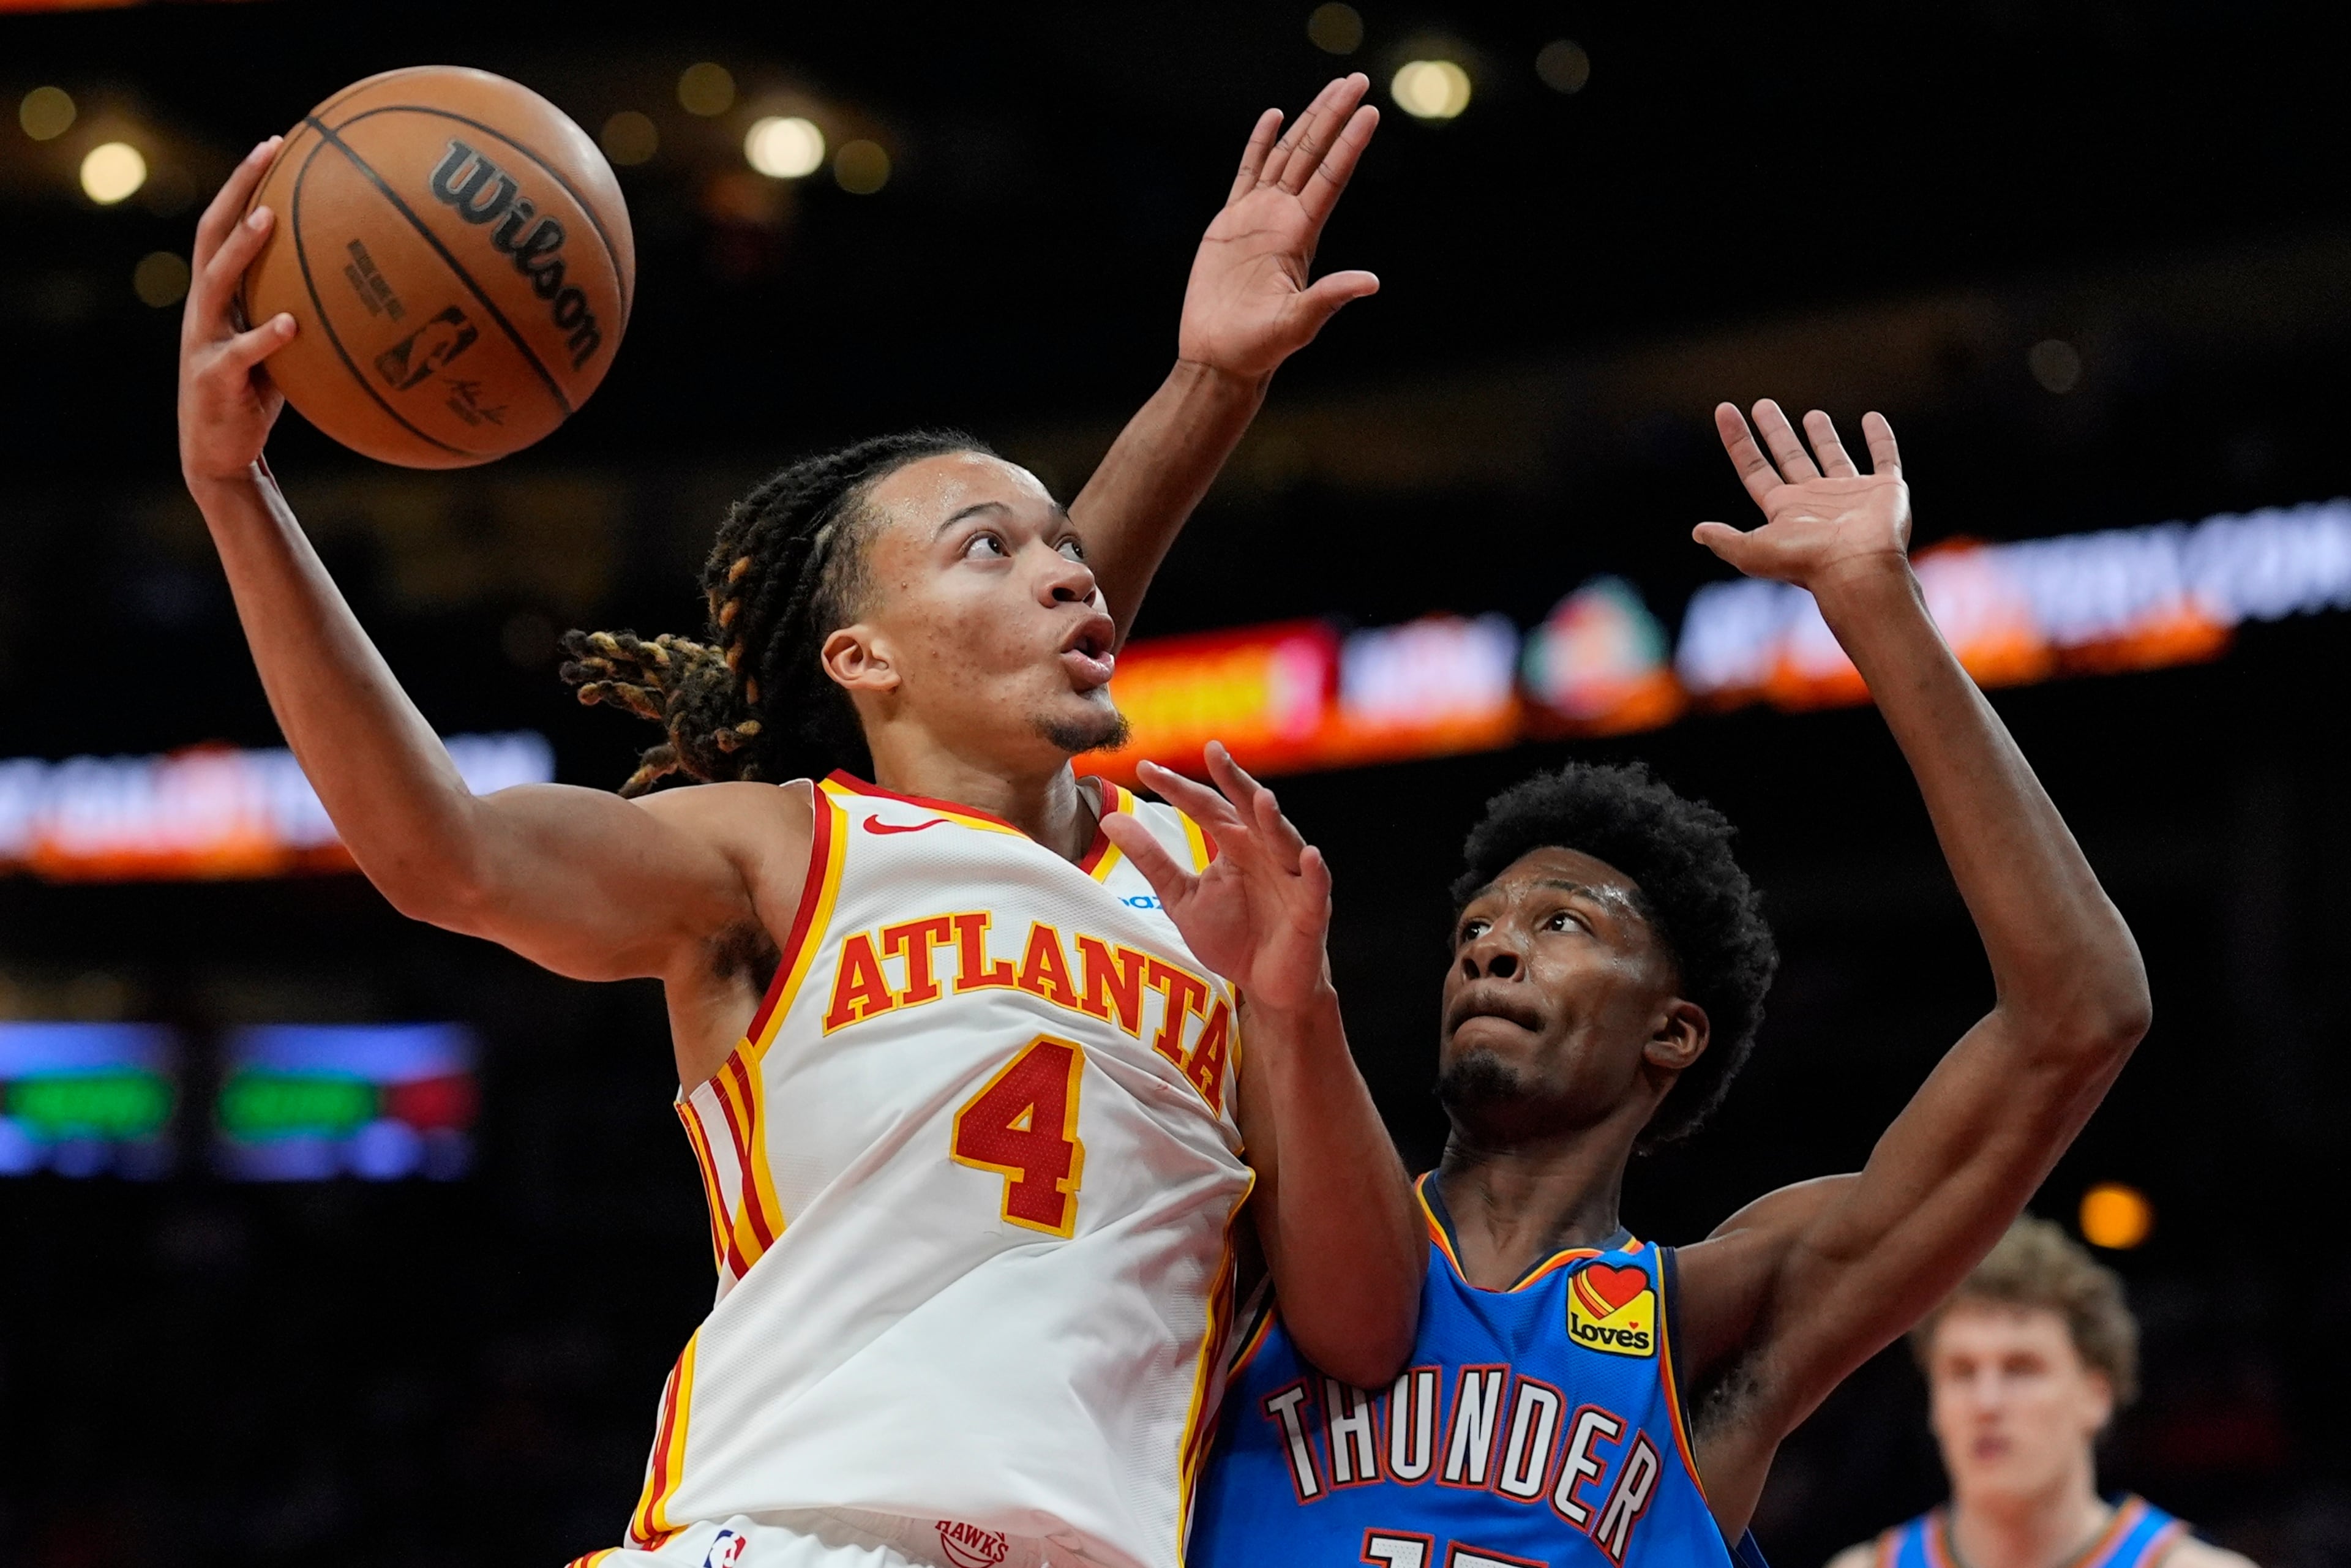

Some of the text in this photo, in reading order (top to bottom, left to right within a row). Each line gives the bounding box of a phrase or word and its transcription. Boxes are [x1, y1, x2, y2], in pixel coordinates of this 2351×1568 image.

[430, 139, 602, 371] Wilson
[822, 910, 1231, 1120] ATLANTA
[950, 1033, 1086, 1239] 4
[1261, 1364, 1660, 1568] THUNDER
